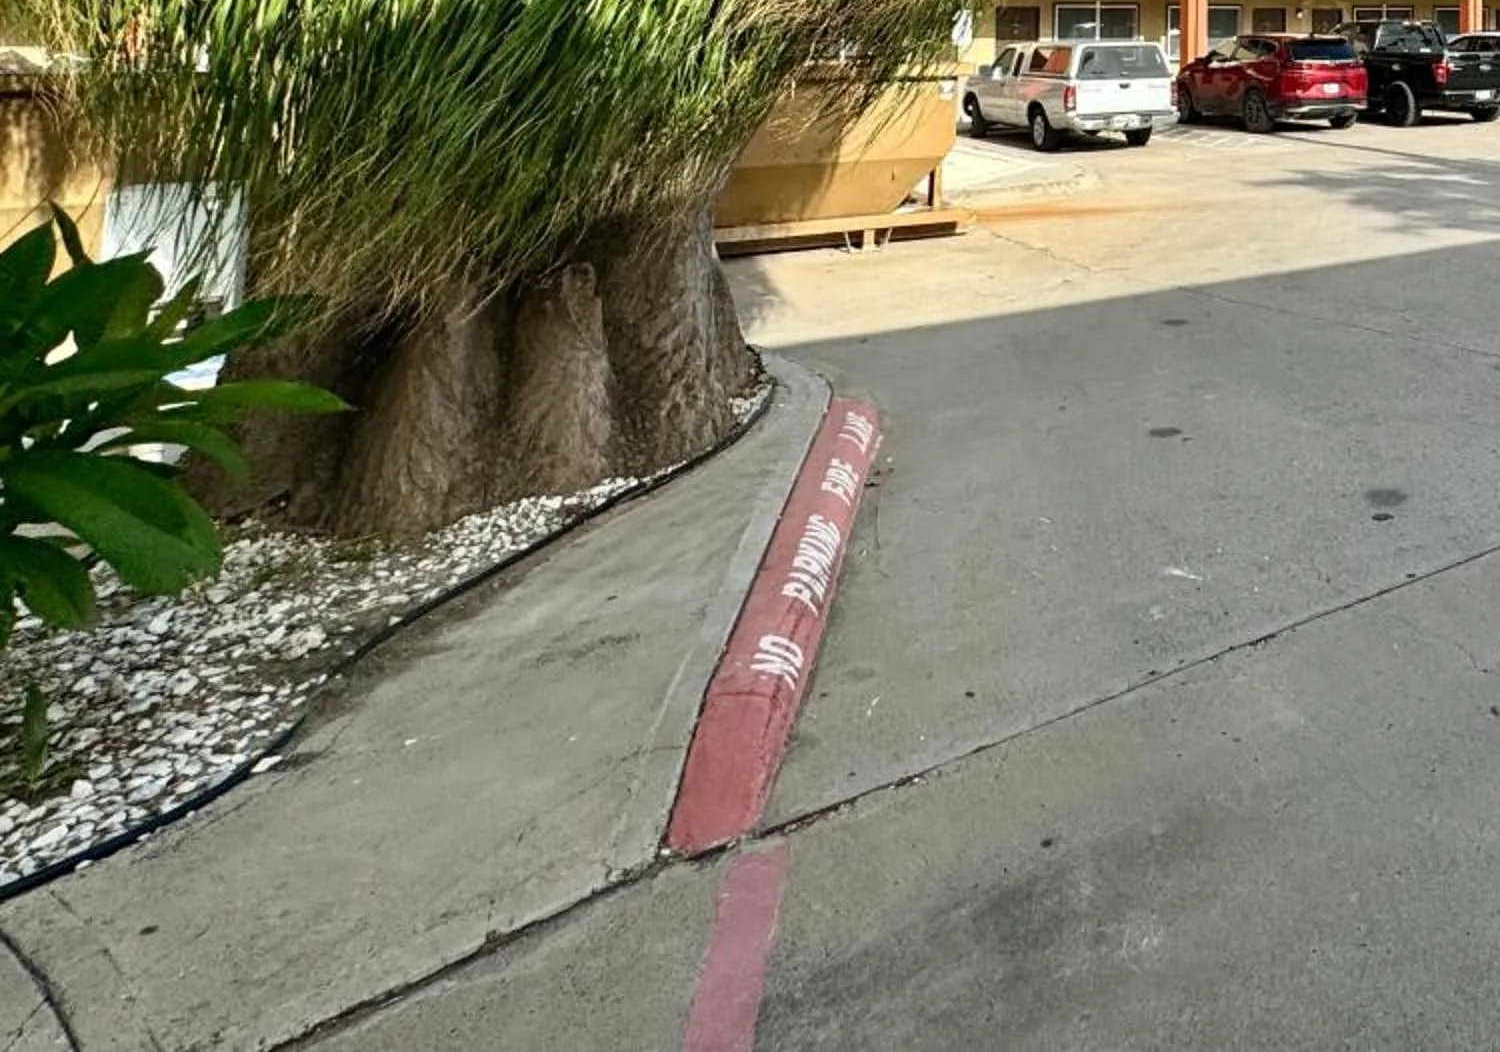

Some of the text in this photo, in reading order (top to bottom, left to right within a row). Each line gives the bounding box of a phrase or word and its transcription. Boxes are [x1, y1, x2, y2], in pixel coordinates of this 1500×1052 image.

[750, 411, 873, 691] NO PARKING FIRE LANE
